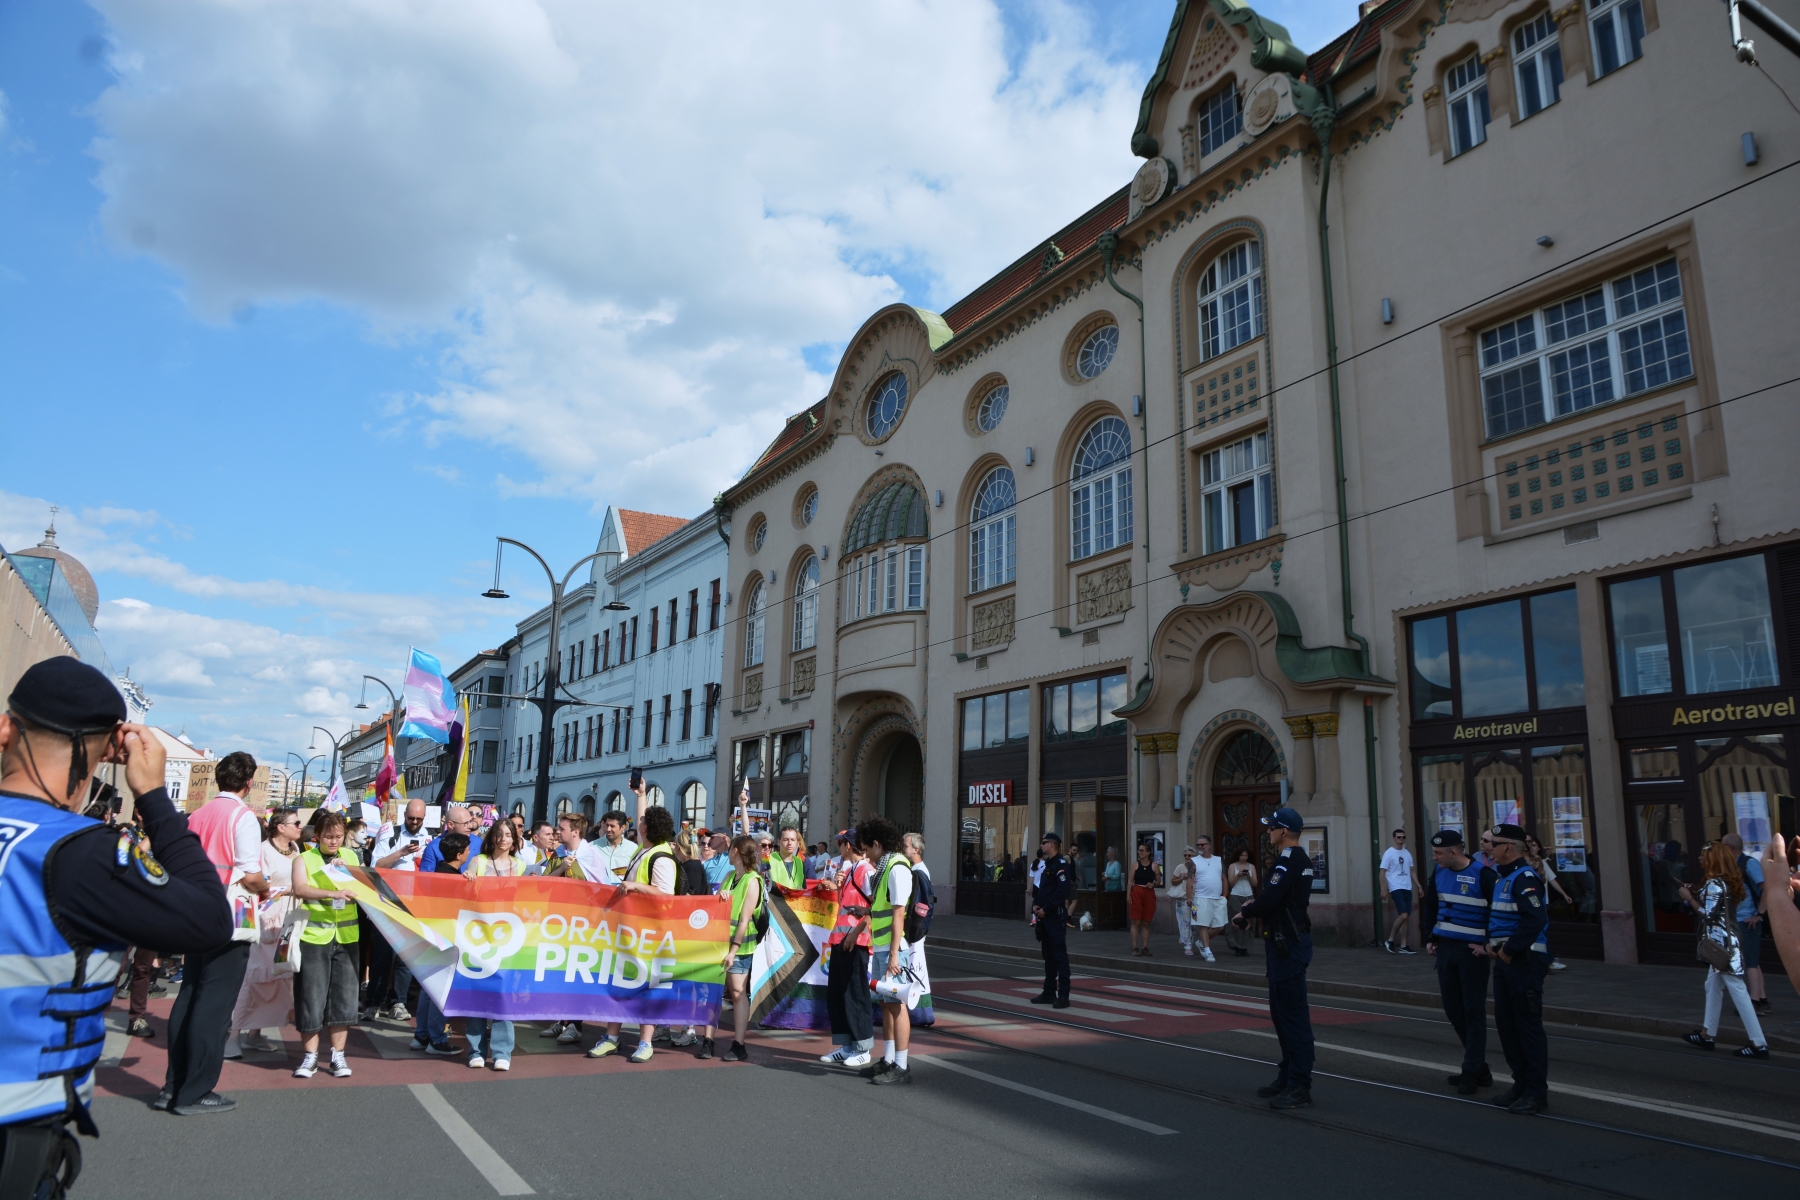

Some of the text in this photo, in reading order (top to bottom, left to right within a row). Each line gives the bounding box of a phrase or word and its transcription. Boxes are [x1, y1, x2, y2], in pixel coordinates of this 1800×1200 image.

[1672, 696, 1795, 726] Aerotravel
[1453, 717, 1538, 740] Aerotravel
[968, 783, 1008, 805] DIESEL
[540, 913, 677, 955] ORADEA
[534, 942, 677, 990] PRIDE
[910, 962, 923, 972] Ark
